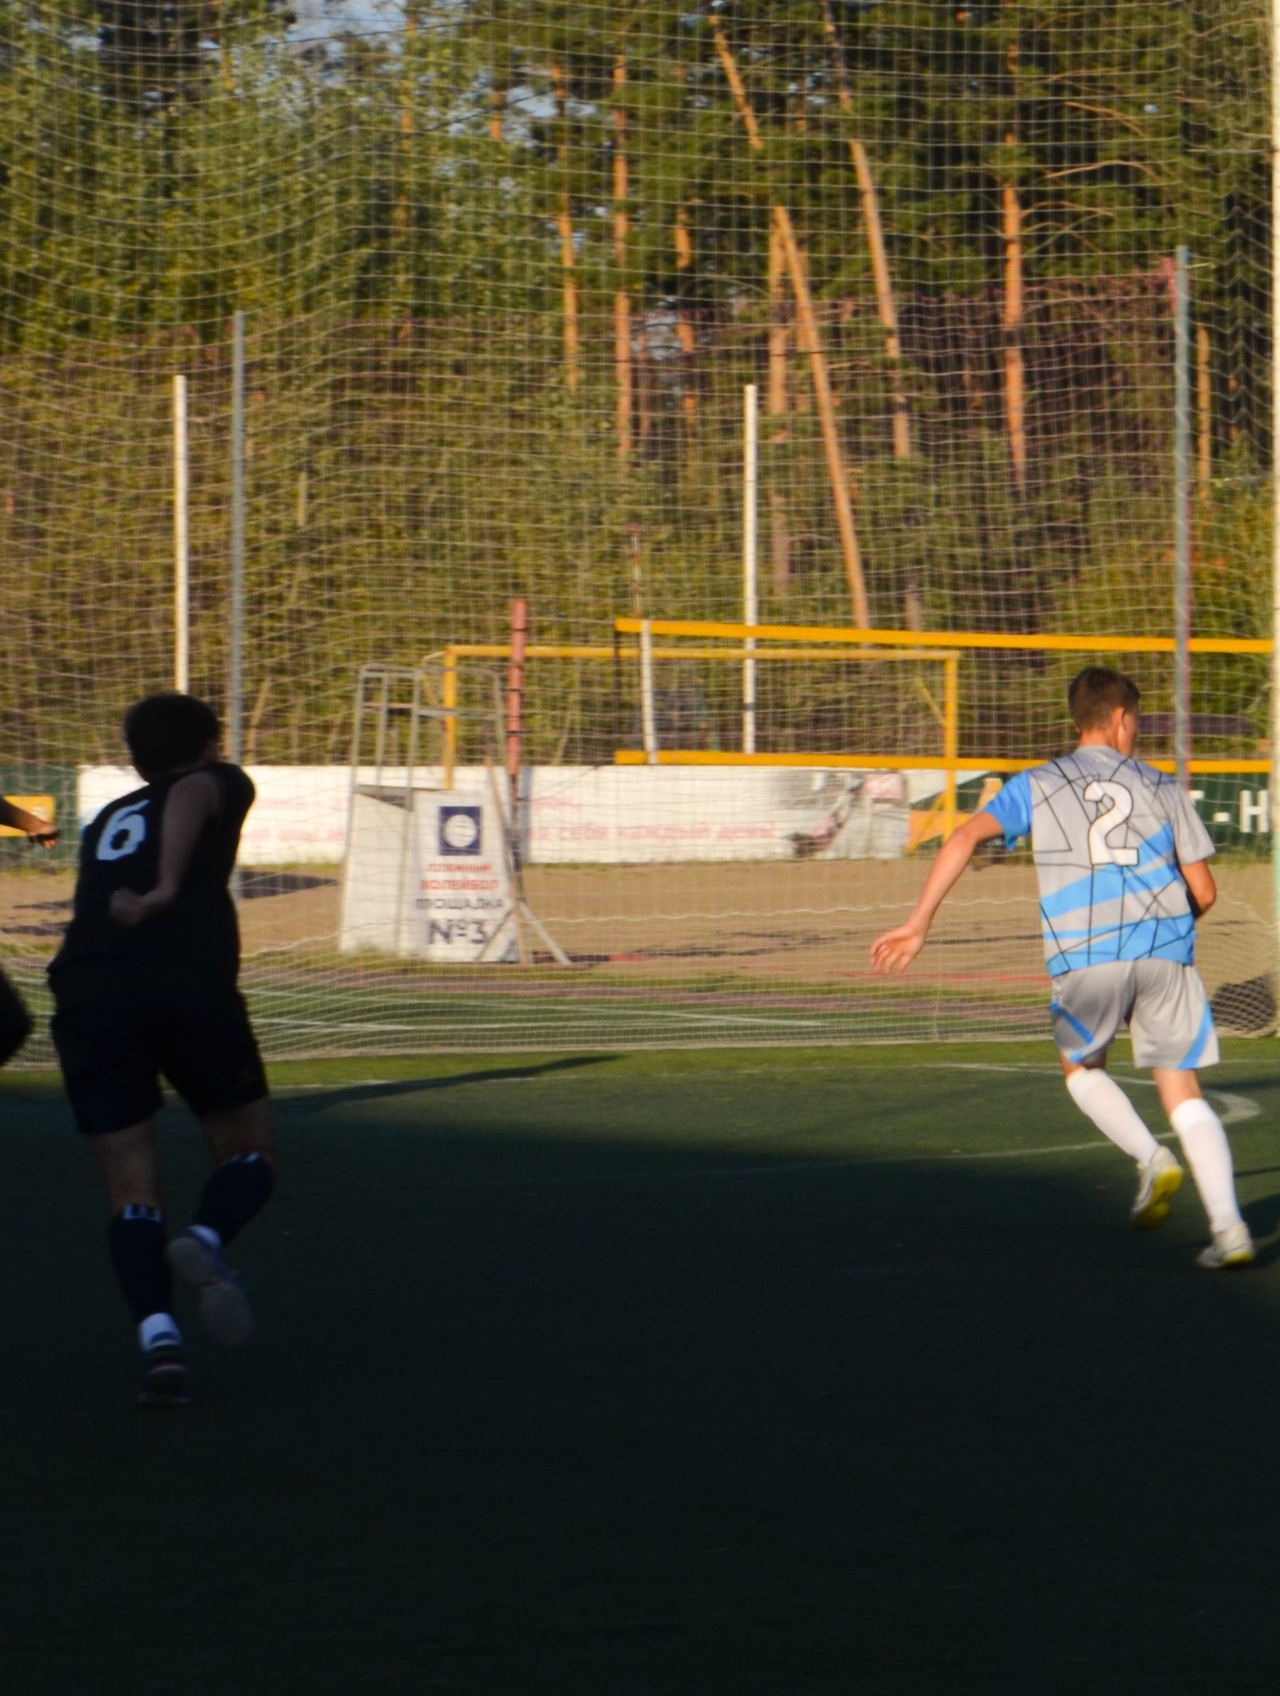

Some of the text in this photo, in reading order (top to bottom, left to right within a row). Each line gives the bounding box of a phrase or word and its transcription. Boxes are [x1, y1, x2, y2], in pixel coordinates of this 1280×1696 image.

[96, 799, 150, 861] 6
[1083, 780, 1139, 867] 2
[416, 898, 504, 910] ПЛОЩАДКА
